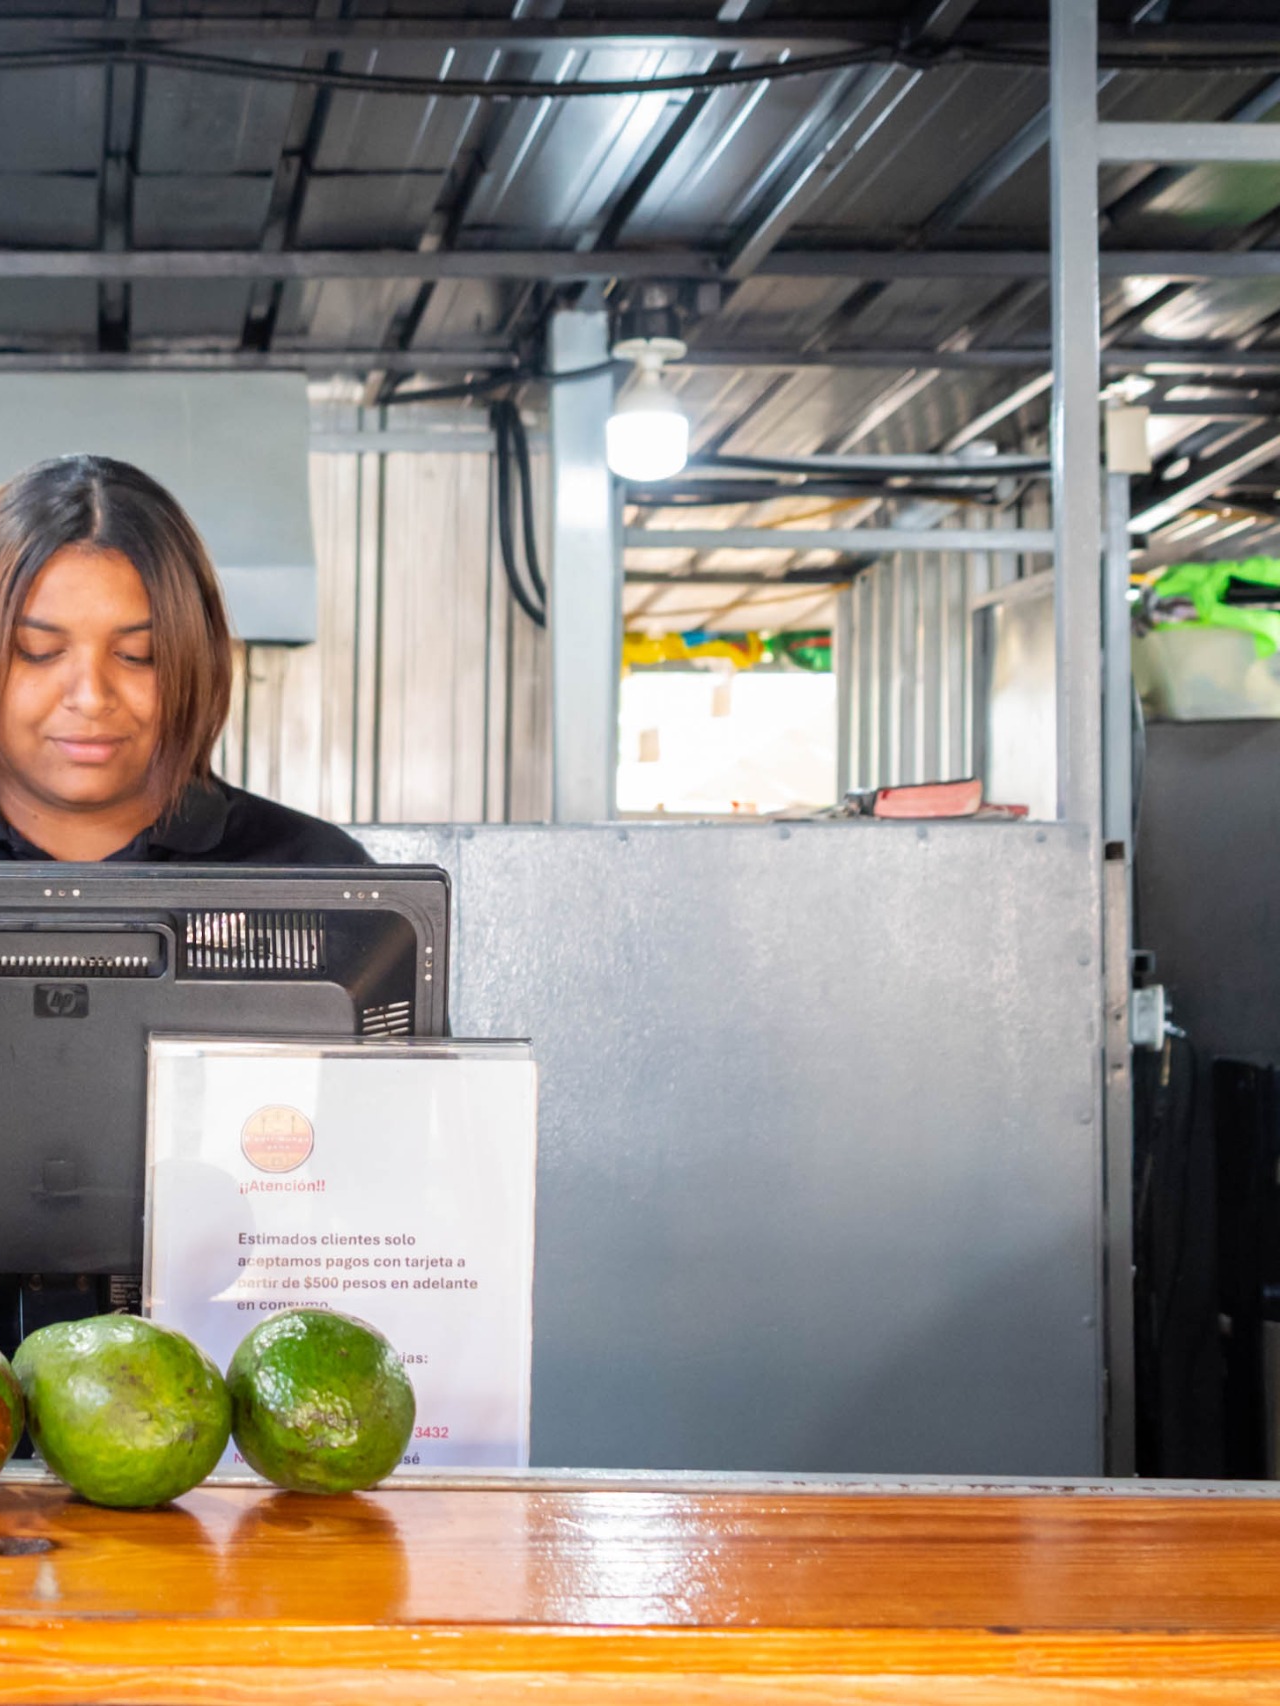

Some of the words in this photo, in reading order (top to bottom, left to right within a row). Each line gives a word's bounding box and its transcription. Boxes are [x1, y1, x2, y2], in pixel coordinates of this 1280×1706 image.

[239, 1179, 326, 1195] ¡¡Atención!!
[238, 1232, 318, 1246] Estimados
[320, 1232, 381, 1246] clientes
[384, 1232, 416, 1246] solo
[238, 1256, 321, 1269] aceptamos
[325, 1257, 370, 1271] pagos
[373, 1257, 401, 1268] con
[405, 1255, 453, 1271] tarjeta
[457, 1257, 466, 1268] a
[237, 1277, 279, 1292] partir
[282, 1276, 300, 1289] de
[304, 1276, 339, 1291] $500
[342, 1279, 387, 1292] pesos
[390, 1279, 409, 1290] en
[412, 1277, 479, 1290] adelante
[237, 1300, 255, 1311] en
[396, 1352, 429, 1365] ias:
[414, 1426, 449, 1440] 3432
